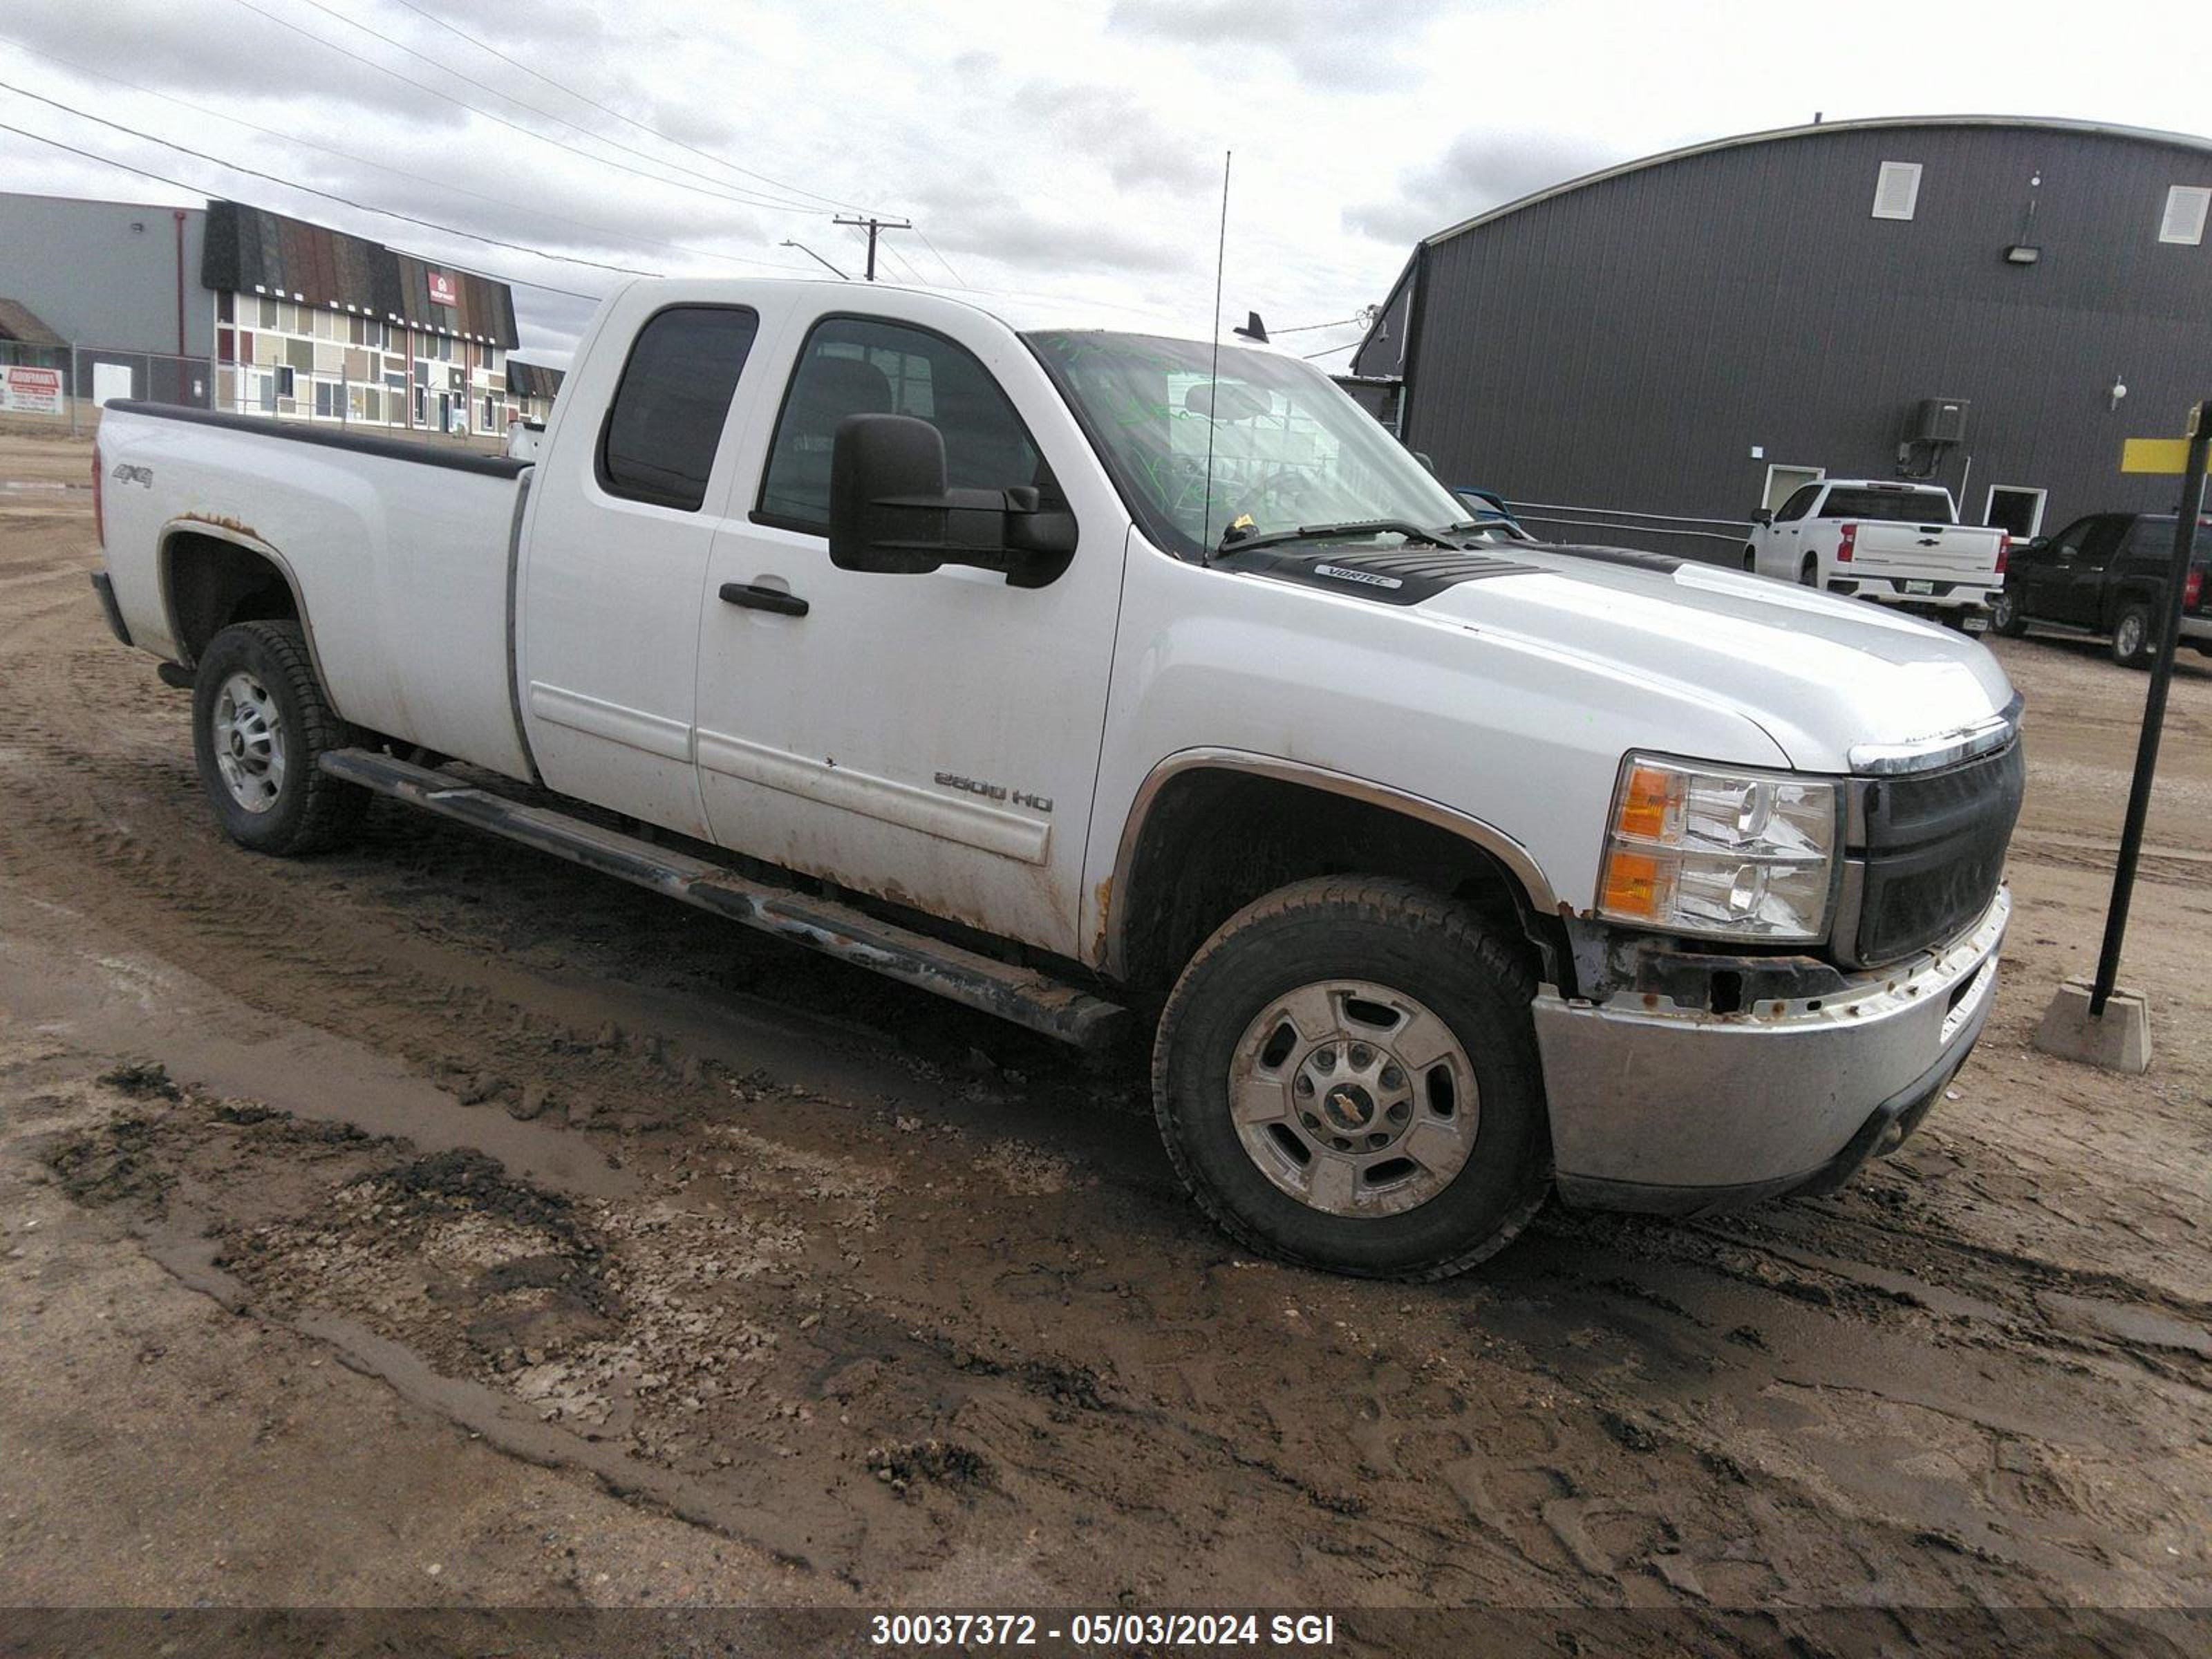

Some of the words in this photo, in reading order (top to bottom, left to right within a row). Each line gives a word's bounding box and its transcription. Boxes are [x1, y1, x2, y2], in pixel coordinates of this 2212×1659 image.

[1329, 567, 1391, 585] VORTEC
[935, 772, 1006, 800] 2500
[1012, 789, 1054, 812] HD
